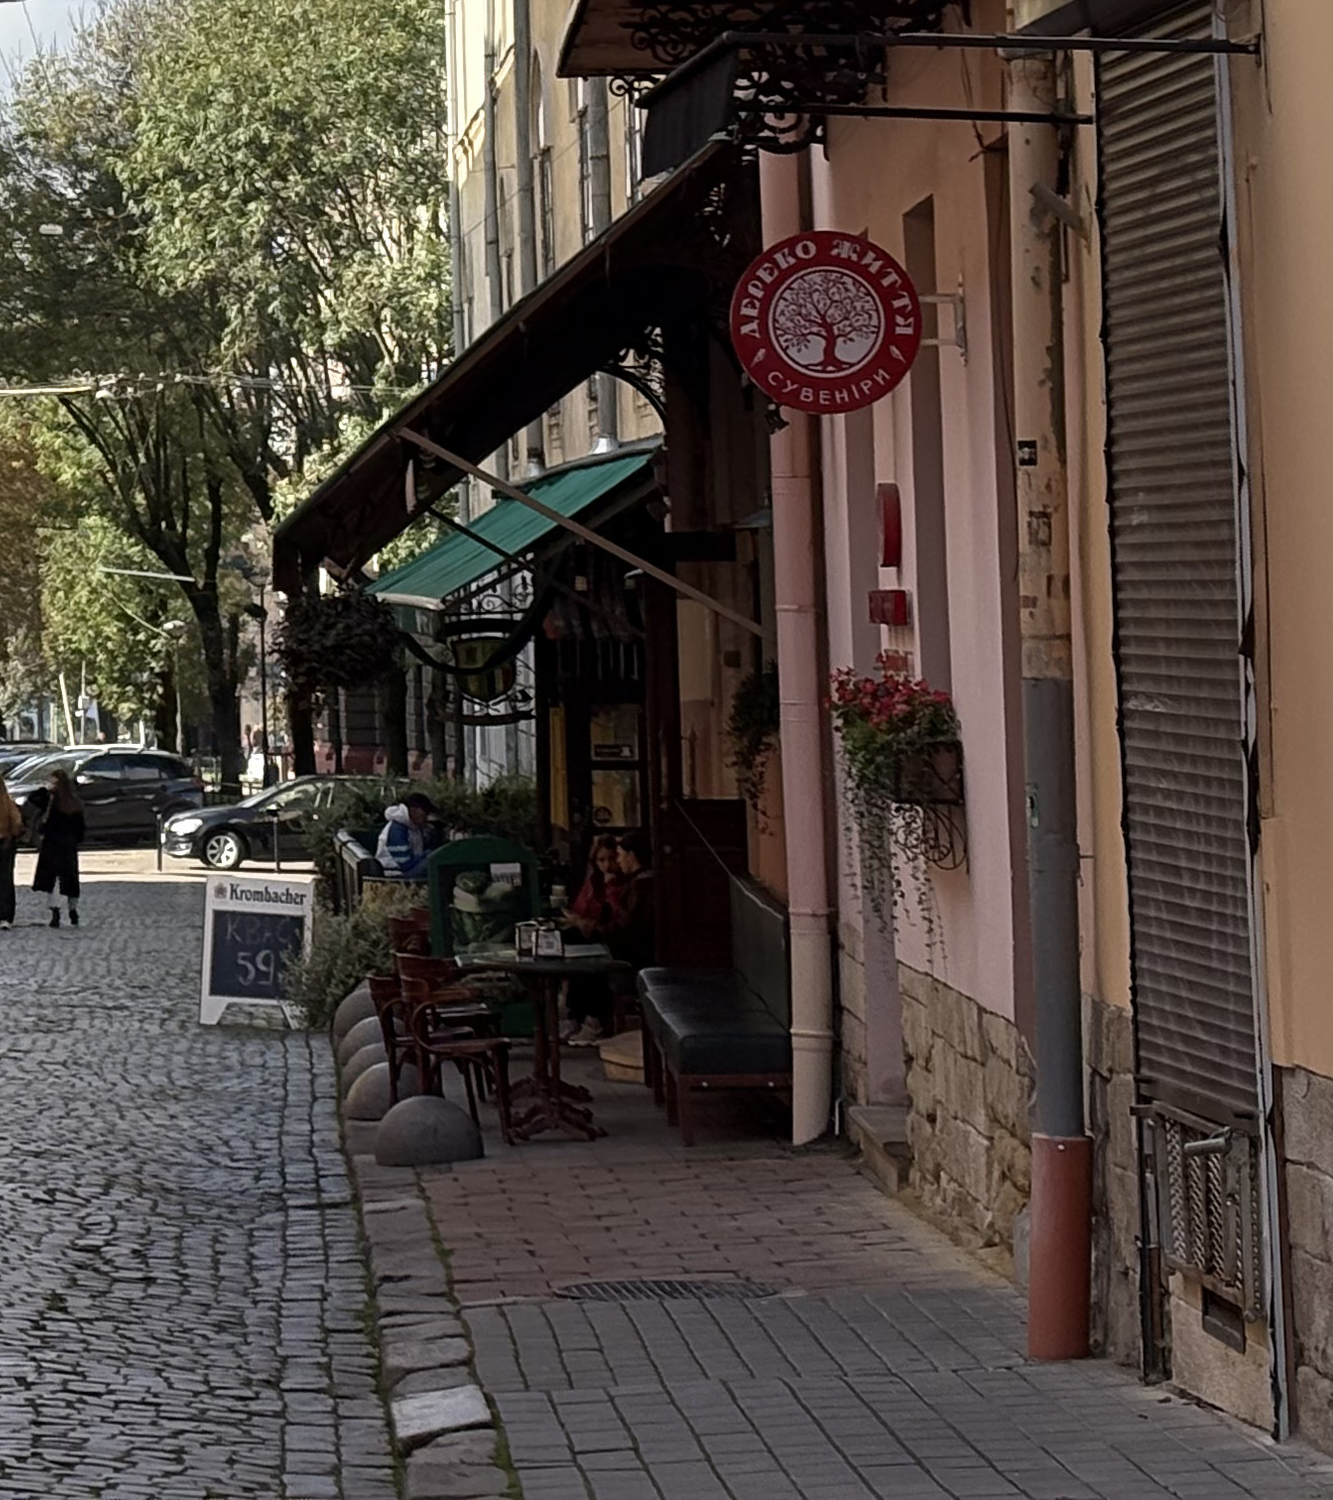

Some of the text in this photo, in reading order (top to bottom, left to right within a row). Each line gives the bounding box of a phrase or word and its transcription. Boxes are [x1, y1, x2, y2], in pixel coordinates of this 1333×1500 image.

[830, 239, 914, 335] ЖИТТЯ
[767, 368, 891, 404] СУВЕНІРИ
[229, 883, 307, 906] Krombacher
[237, 949, 275, 987] 59
